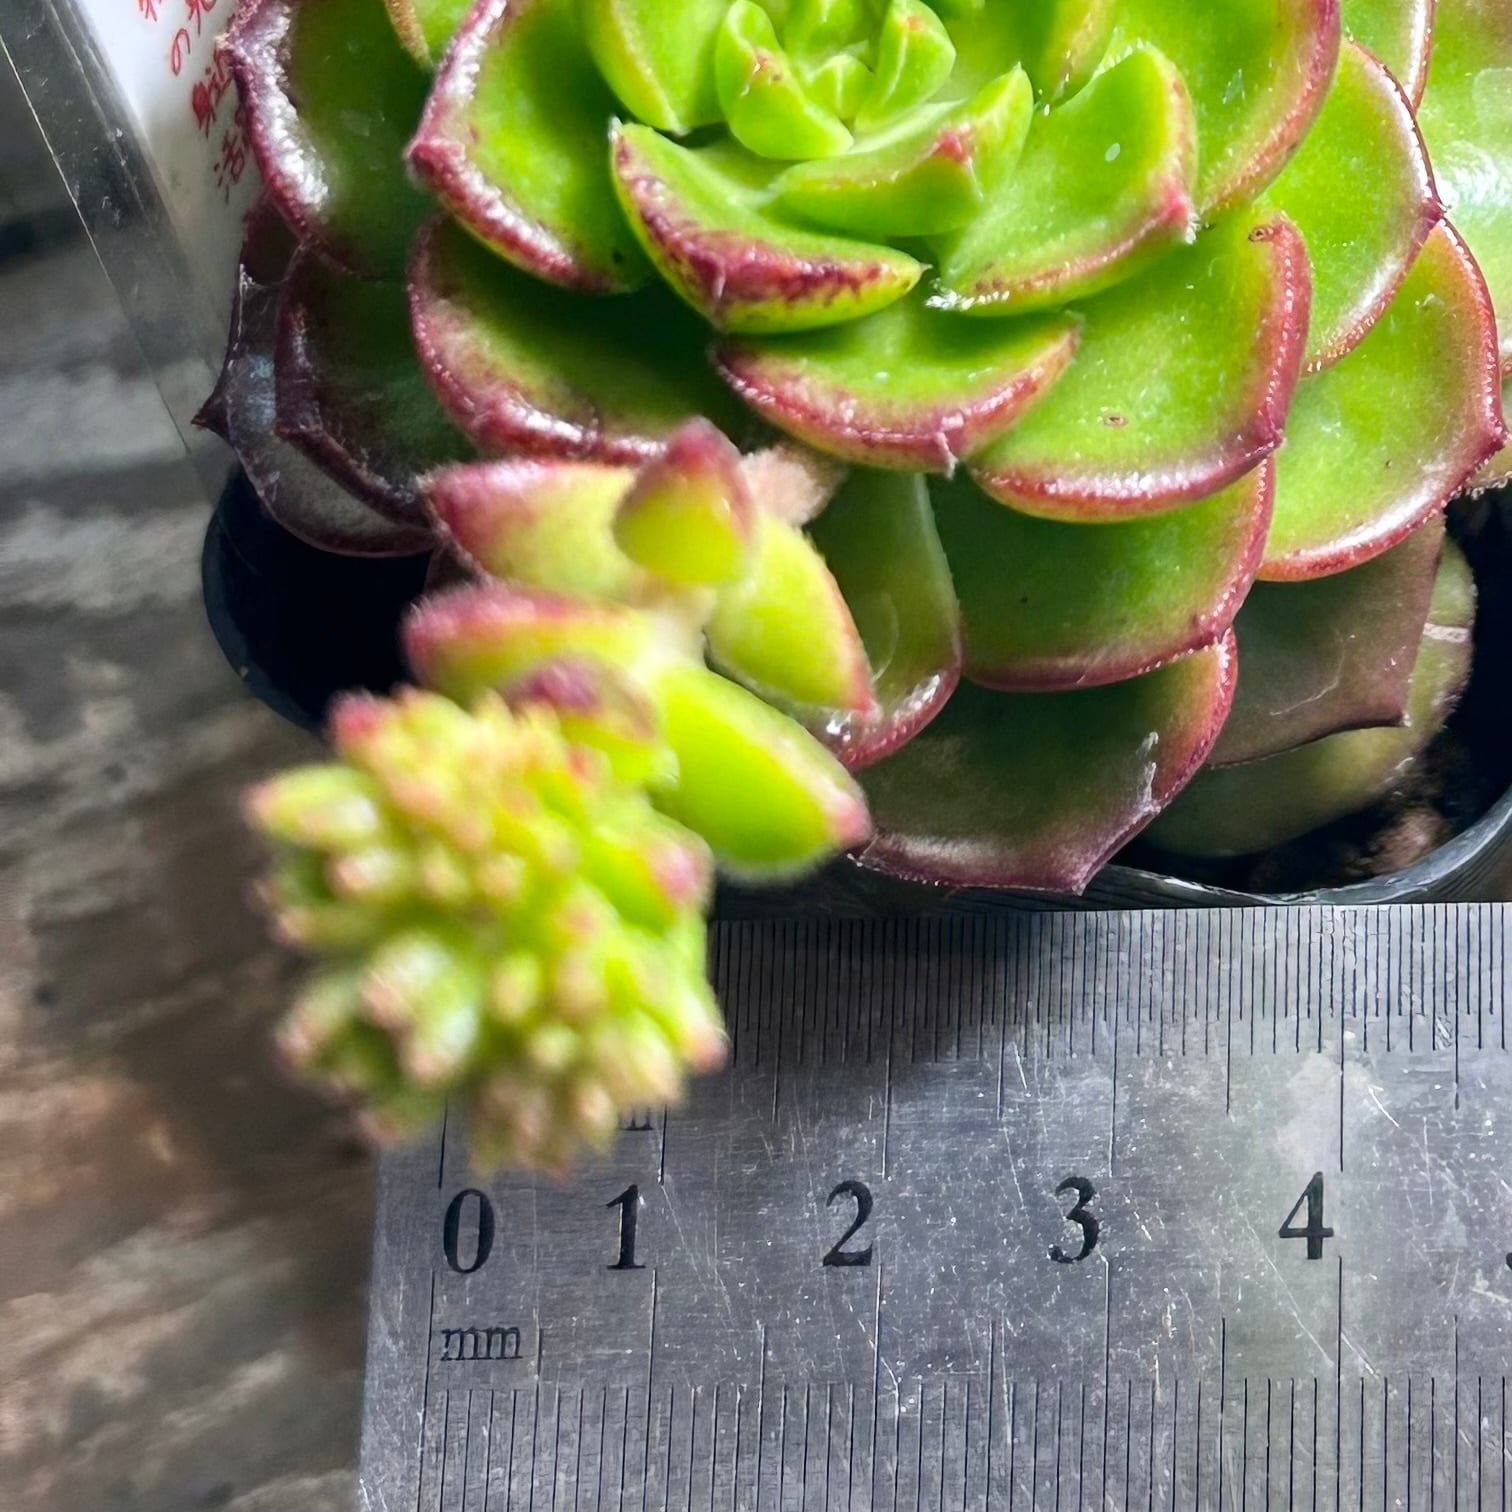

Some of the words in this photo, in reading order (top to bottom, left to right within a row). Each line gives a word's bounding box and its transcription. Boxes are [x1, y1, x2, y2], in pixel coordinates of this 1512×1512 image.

[442, 1188, 496, 1275] 0
[606, 1184, 646, 1271] 1
[823, 1181, 874, 1268] 2
[1049, 1176, 1100, 1265] 3
[1278, 1171, 1335, 1261] 4
[440, 1326, 523, 1363] mm
